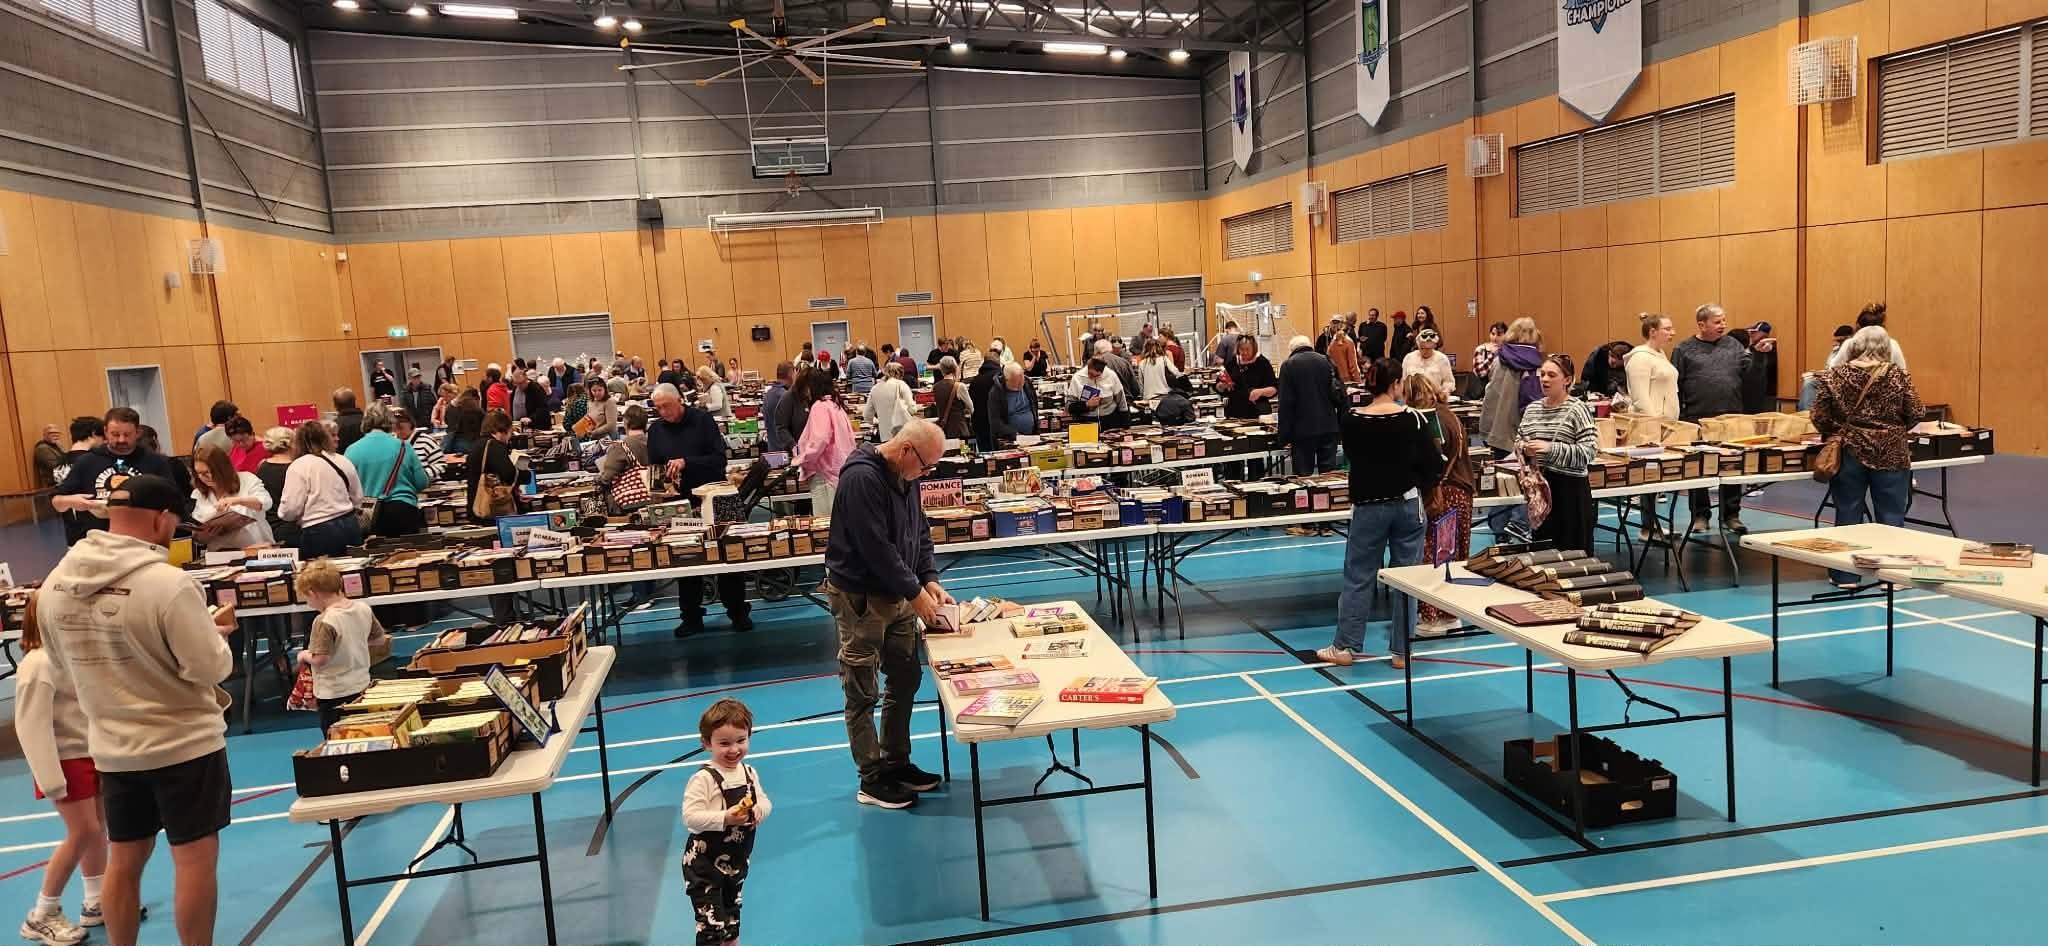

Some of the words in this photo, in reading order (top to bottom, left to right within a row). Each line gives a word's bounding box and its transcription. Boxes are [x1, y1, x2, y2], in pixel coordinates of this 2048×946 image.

[920, 481, 962, 491] ROMANCE
[533, 533, 562, 543] ROMANCE
[1061, 694, 1099, 702] CARTER'S
